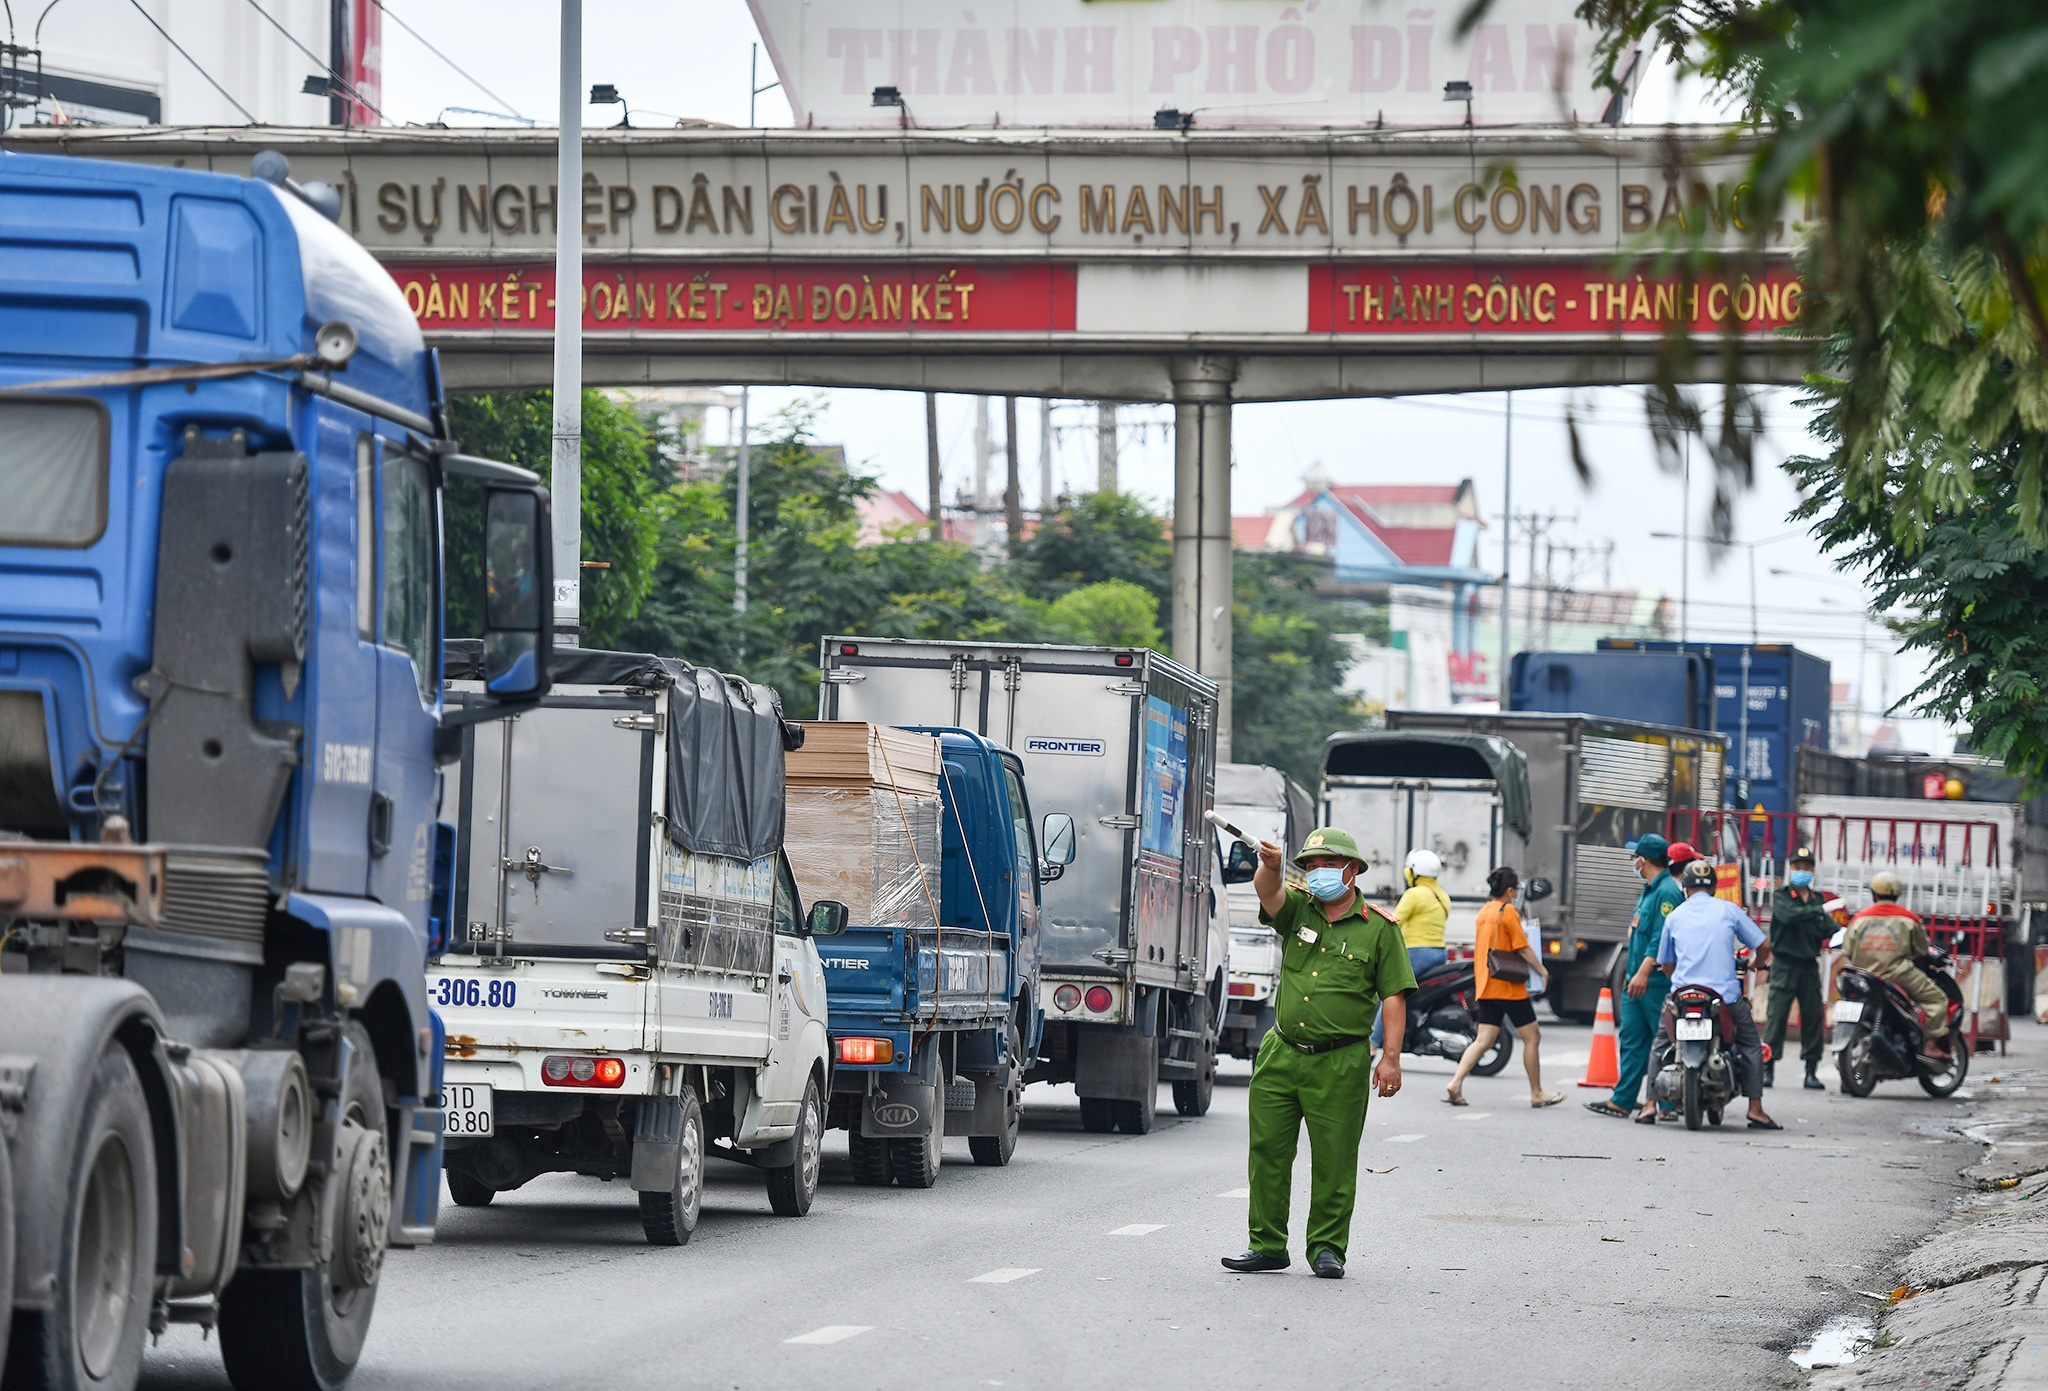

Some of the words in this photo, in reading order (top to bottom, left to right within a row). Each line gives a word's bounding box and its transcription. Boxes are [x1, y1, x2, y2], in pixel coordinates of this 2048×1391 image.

[826, 11, 1117, 96] THÀNH
[1149, 0, 1320, 95] PHỐ
[1349, 8, 1435, 94] DĨ
[1471, 23, 1578, 94] AN
[377, 175, 446, 245] SỰ
[458, 171, 638, 245] NGHỆP
[652, 172, 755, 235] DÂN
[770, 170, 905, 243] GIÀU,
[920, 168, 1062, 235] NƯỚC
[1079, 183, 1240, 243] MẠNH,
[1257, 173, 1330, 236] XÃ
[1346, 172, 1433, 244] HỘI
[1454, 170, 1601, 235] CÔNG
[478, 269, 543, 322] KẾT
[581, 272, 656, 322] OÀN
[665, 270, 730, 321] KẾT
[752, 283, 804, 328] ĐẠI
[811, 274, 903, 322] ĐOÀN
[910, 269, 975, 322] KẾT
[1342, 275, 1455, 323] THÀNH
[1462, 274, 1557, 323] CÔNG
[1584, 273, 1700, 322] THÀNH
[1707, 272, 1803, 322] CÔNG
[1029, 740, 1101, 753] FRONTIER
[541, 987, 608, 1000] TOWNER
[882, 1109, 911, 1122] KIA
